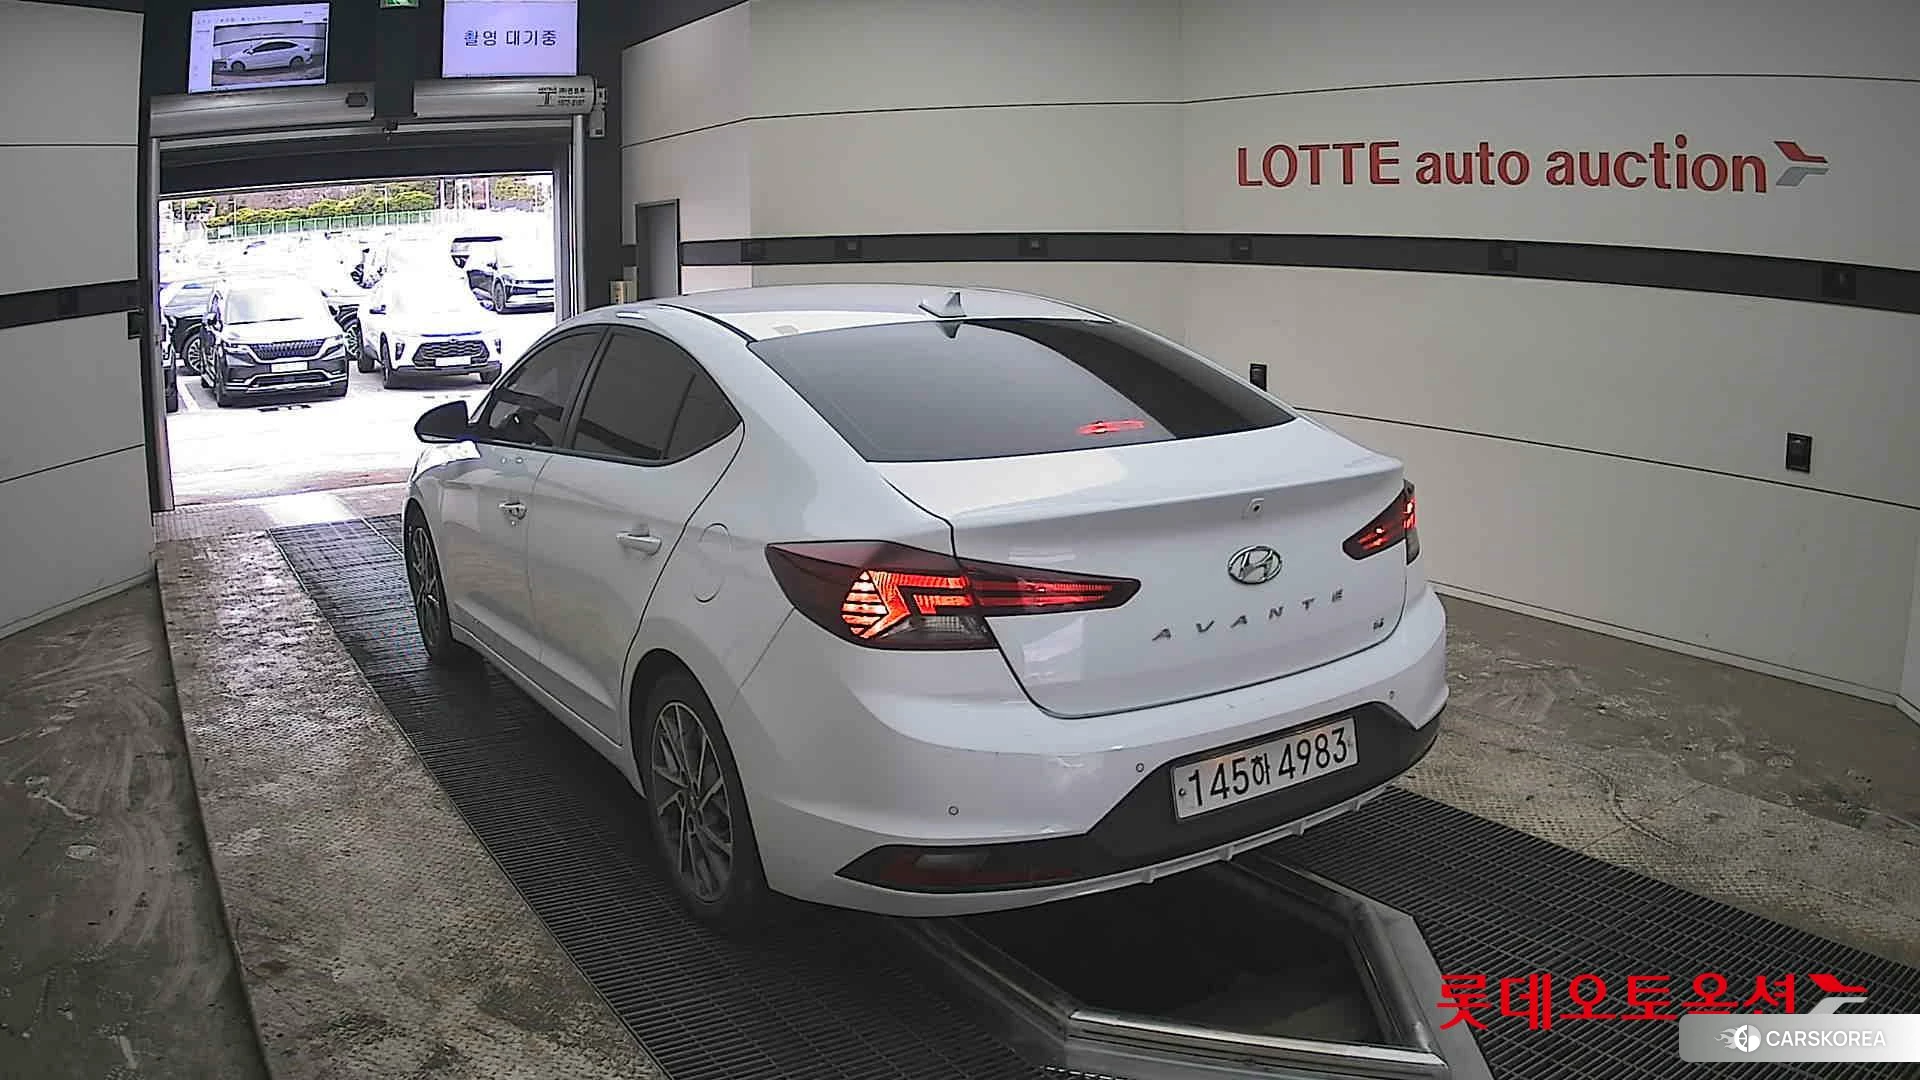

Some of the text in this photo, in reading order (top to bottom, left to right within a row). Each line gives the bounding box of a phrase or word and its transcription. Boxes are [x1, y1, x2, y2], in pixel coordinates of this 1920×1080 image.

[464, 30, 557, 47] 촬영 대기중
[1237, 134, 1768, 194] LOTTE auto auction
[1152, 588, 1344, 642] AVANTE
[1277, 727, 1348, 780] 4983
